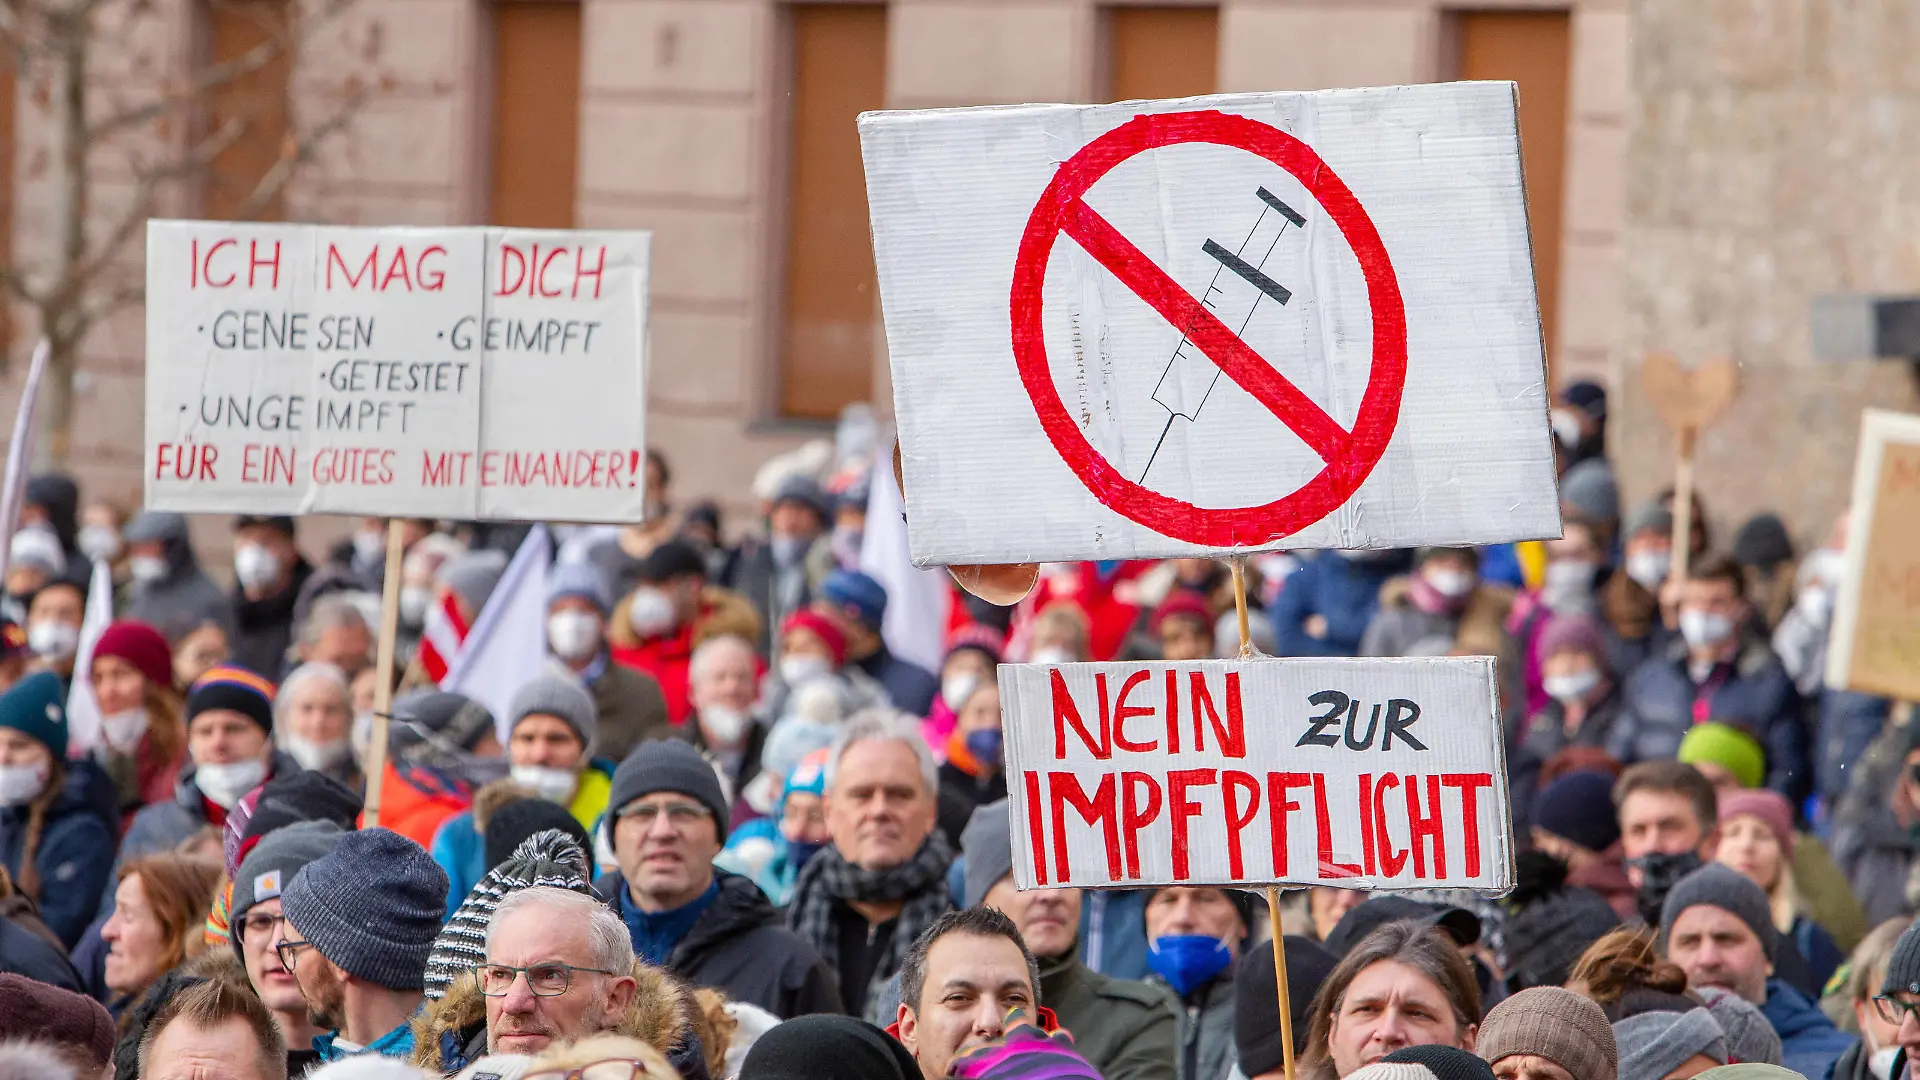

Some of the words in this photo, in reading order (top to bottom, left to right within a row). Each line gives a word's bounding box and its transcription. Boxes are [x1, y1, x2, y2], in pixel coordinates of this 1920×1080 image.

[190, 238, 281, 290] ICH
[325, 244, 448, 293] MAG
[492, 244, 607, 300] DICH
[154, 433, 218, 482] FÜR
[241, 445, 296, 486] EIN
[312, 447, 396, 486] GUTES
[1050, 668, 1247, 760] NEIN
[1295, 689, 1430, 752] ZUR
[1024, 767, 1493, 886] IMPFPFLICHT
